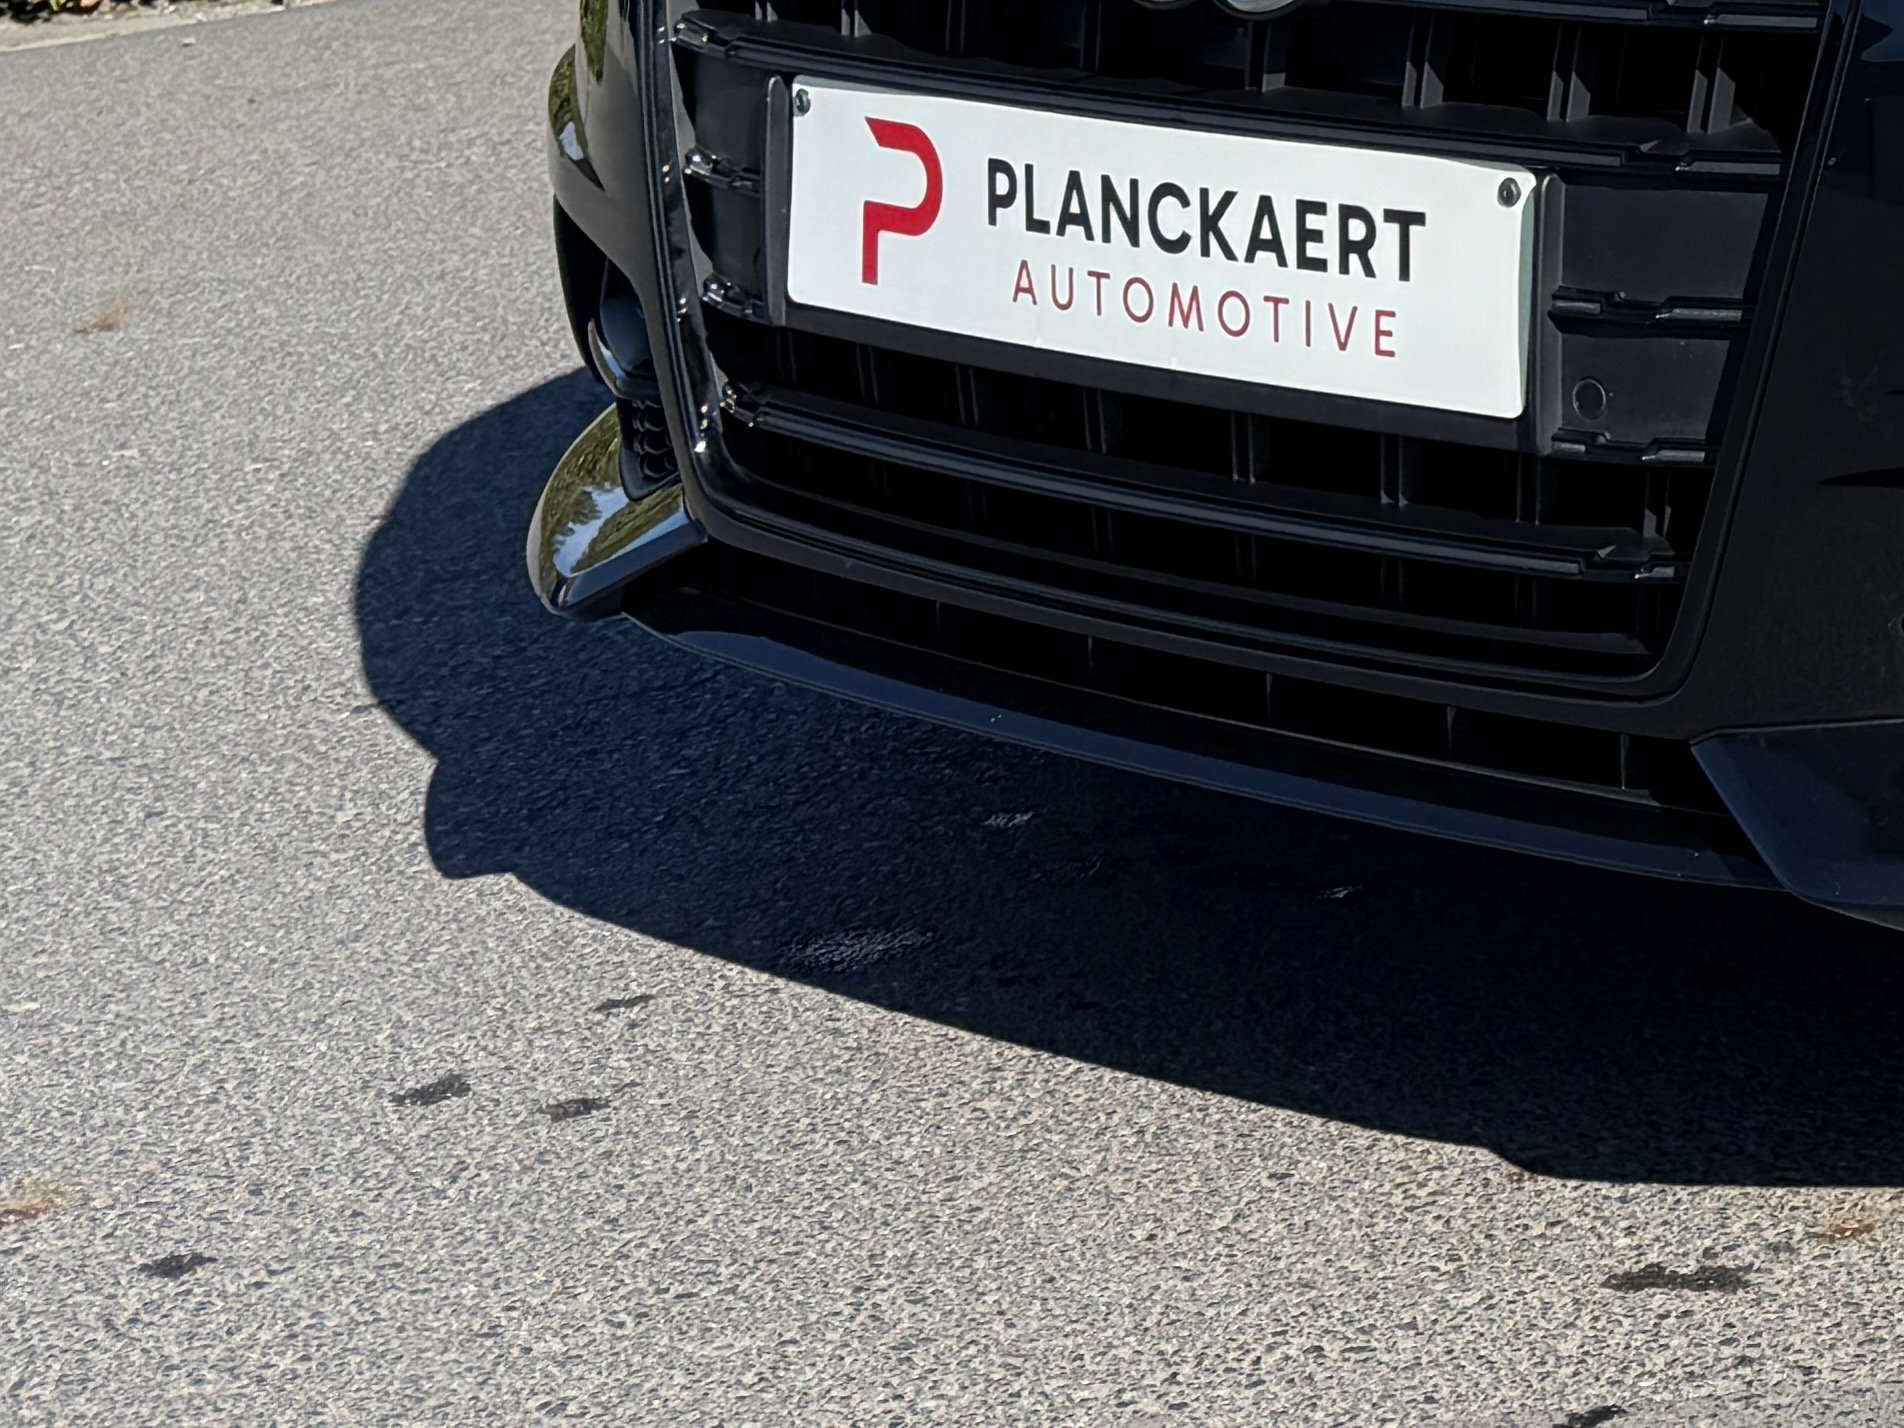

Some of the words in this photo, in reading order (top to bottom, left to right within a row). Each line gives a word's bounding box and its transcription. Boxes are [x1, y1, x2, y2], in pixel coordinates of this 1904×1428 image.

[861, 116, 944, 286] P
[987, 157, 1427, 283] PLANCKAERT
[1012, 259, 1398, 358] AUTOMOTIVE
